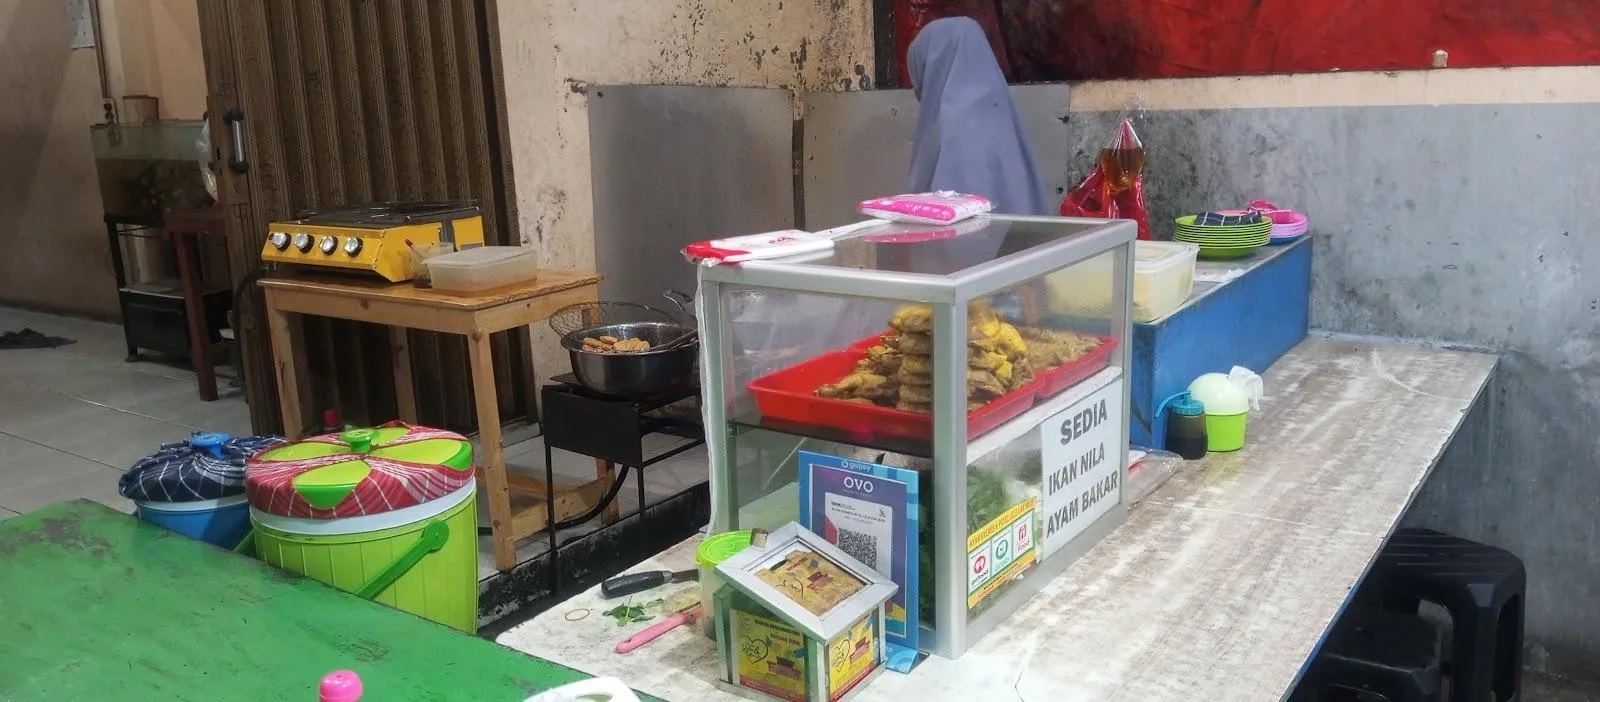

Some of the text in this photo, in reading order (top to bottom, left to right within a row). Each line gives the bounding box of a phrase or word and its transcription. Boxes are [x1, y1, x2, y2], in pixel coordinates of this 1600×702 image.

[1060, 399, 1107, 445] SEDIA
[843, 476, 874, 493] OVO
[849, 463, 871, 472] gopay
[1049, 441, 1105, 496] IKAN NILA
[1046, 470, 1118, 538] AYAM BAKAR
